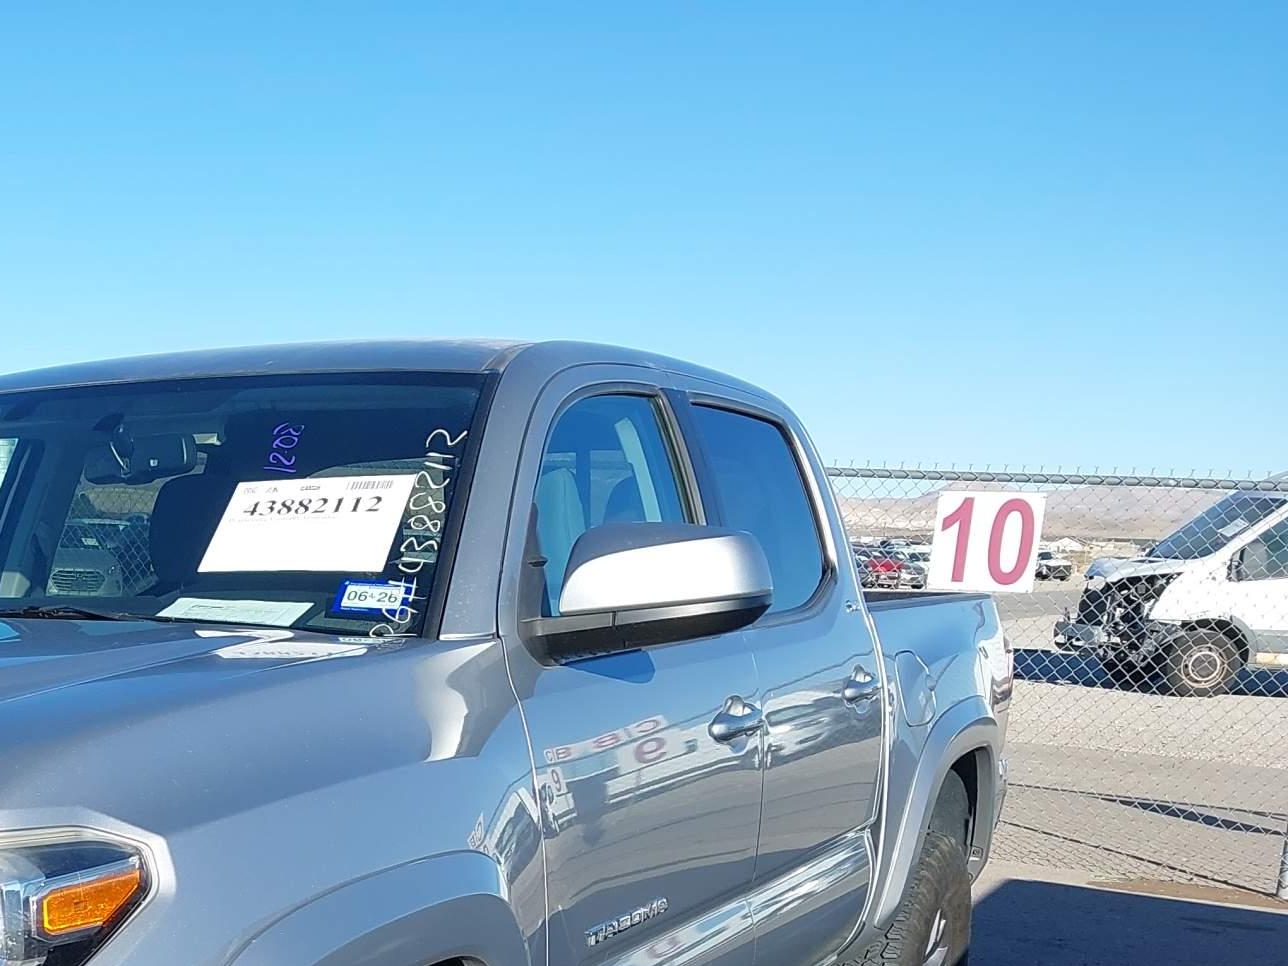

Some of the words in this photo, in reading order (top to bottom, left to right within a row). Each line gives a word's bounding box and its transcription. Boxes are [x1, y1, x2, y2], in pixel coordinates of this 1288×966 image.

[242, 495, 383, 516] 43882112
[941, 496, 1035, 586] 10
[584, 896, 669, 948] TACOMA
